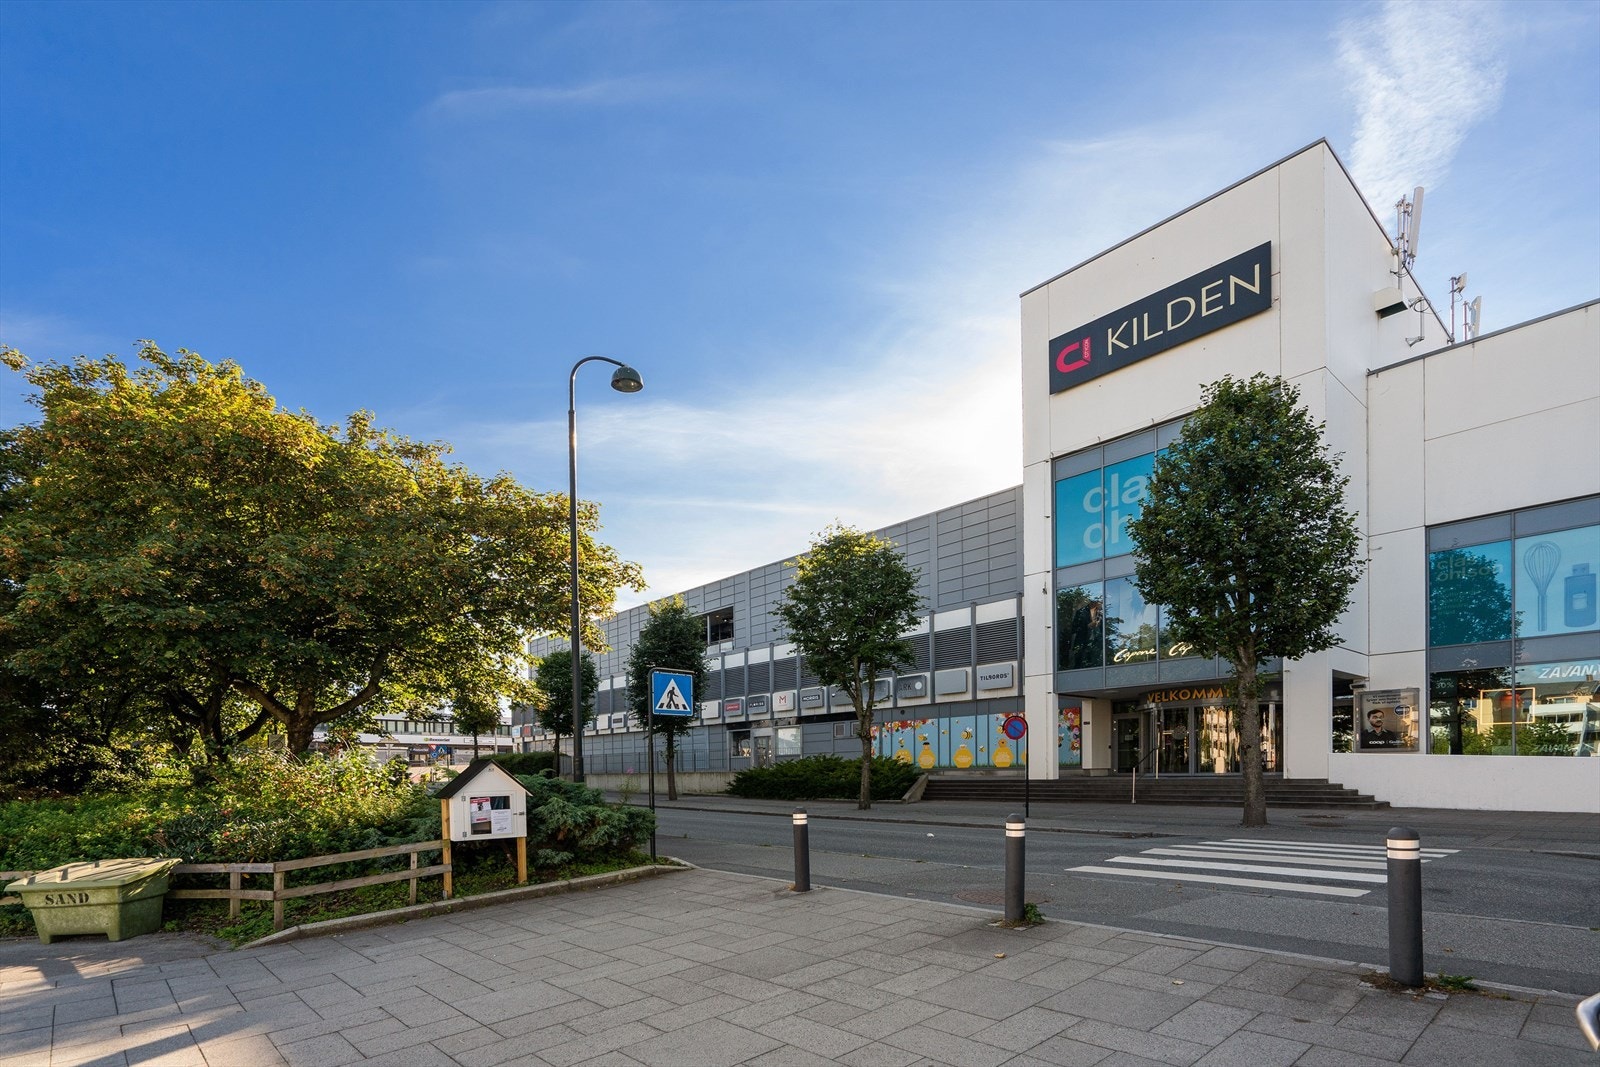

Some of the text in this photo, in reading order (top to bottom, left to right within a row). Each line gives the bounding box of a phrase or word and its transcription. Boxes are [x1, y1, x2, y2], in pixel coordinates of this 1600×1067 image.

[1107, 263, 1261, 356] KILDEN
[1082, 473, 1148, 514] cla
[1082, 508, 1144, 549] oh
[1113, 648, 1158, 663] Capone
[1147, 687, 1230, 703] VELKOMM
[45, 892, 90, 905] SAND
